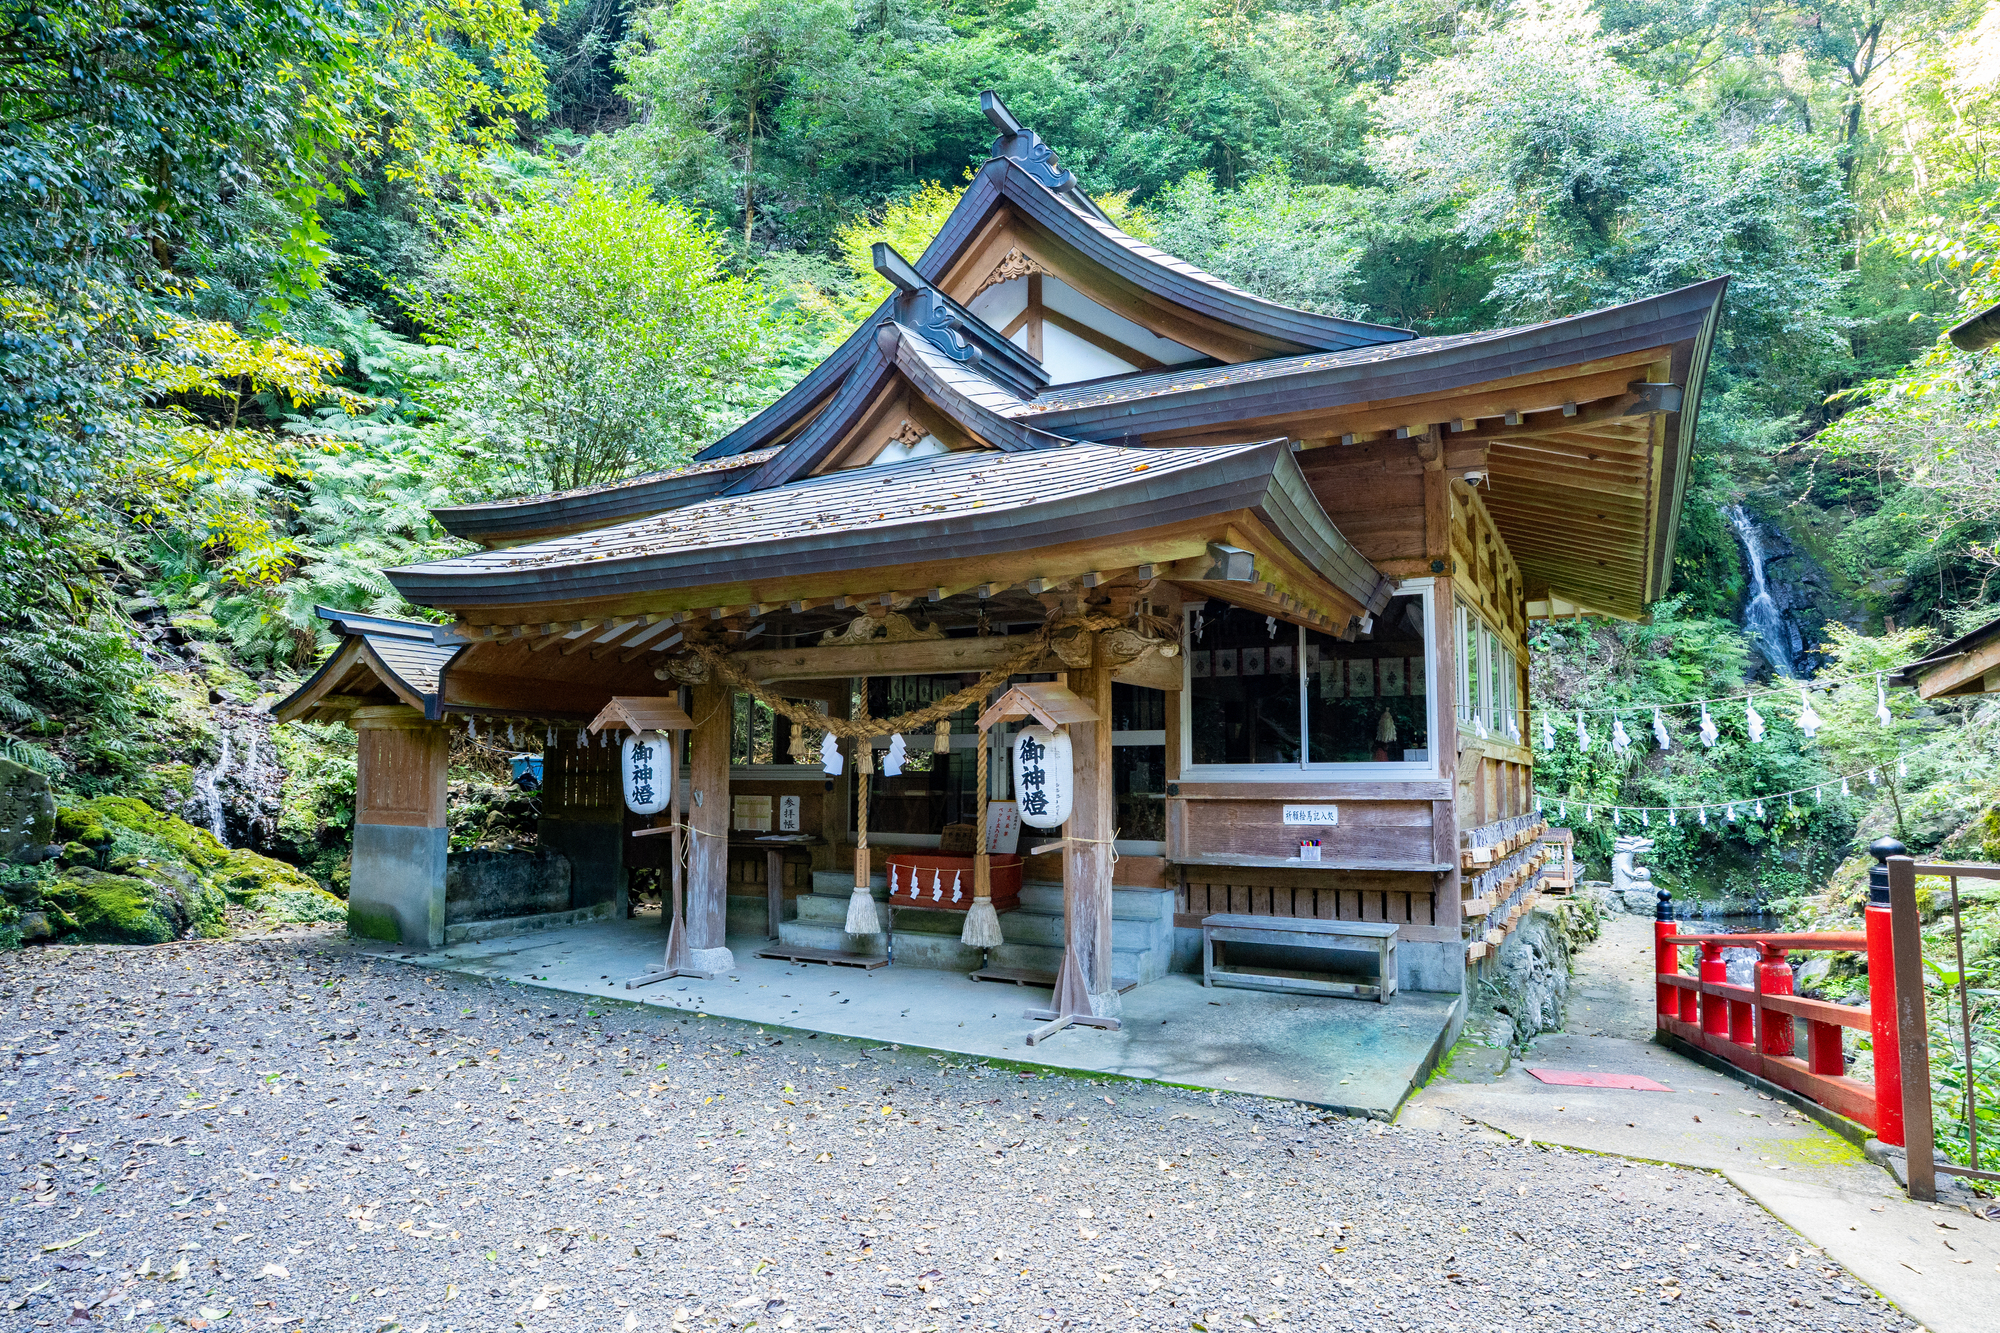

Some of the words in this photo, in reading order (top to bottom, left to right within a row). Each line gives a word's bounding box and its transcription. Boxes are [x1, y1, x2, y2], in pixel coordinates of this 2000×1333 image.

[631, 740, 654, 805] 御神燈
[1019, 736, 1049, 816] 御神燈
[783, 797, 795, 829] 参拝帳
